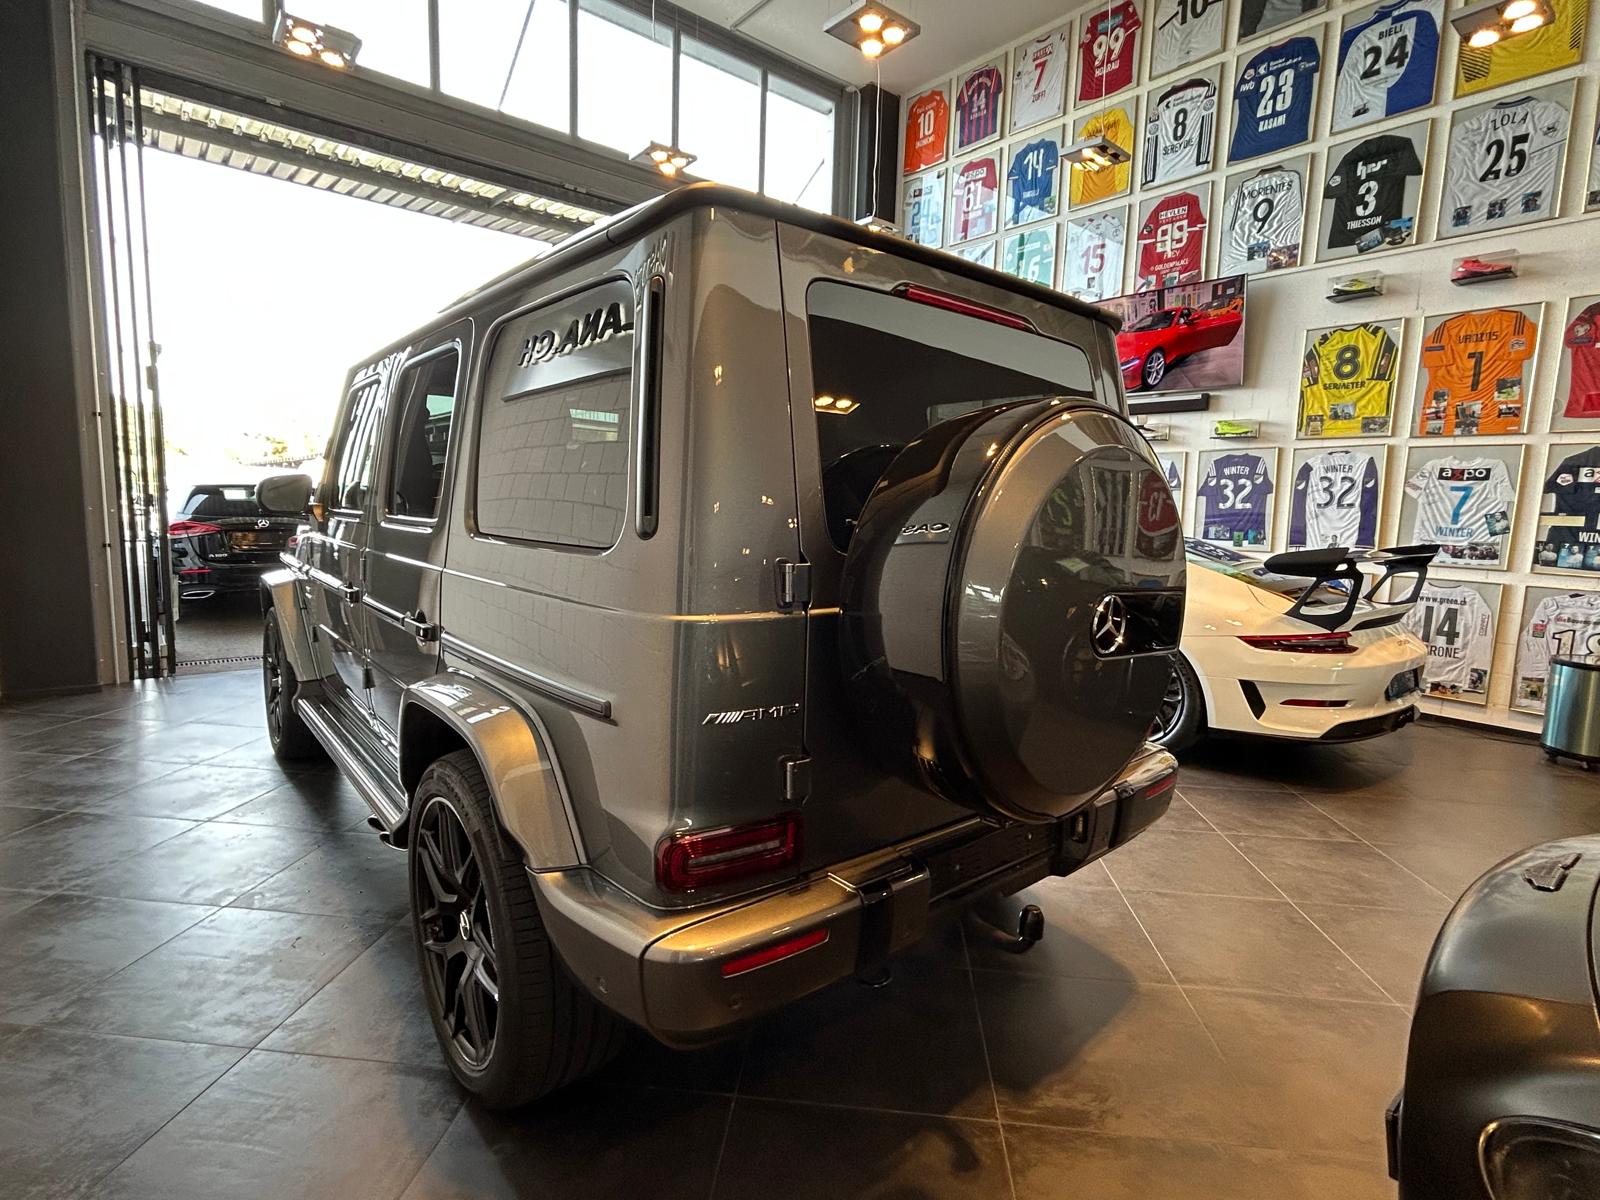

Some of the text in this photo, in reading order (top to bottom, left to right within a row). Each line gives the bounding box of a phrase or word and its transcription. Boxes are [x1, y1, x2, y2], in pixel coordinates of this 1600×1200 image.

[1093, 27, 1125, 67] 99
[1360, 34, 1409, 80] 24
[1034, 59, 1048, 92] 7
[1095, 59, 1120, 77] HORAU
[1257, 68, 1295, 118] 23
[918, 110, 934, 139] 10
[1173, 107, 1187, 141] 8
[1491, 111, 1529, 131] ZOLA
[1024, 148, 1043, 180] 14
[1479, 132, 1530, 182] 25
[964, 180, 983, 210] 61
[1242, 181, 1293, 200] MORIENTES
[1355, 180, 1378, 217] 3
[1160, 207, 1187, 218] HEYLEN
[1253, 198, 1274, 233] 9
[1346, 216, 1382, 230] THIESSON
[1156, 219, 1188, 258] 99
[1081, 243, 1106, 275] 15
[1333, 344, 1361, 380] 8
[1223, 466, 1249, 476] WINTER
[1323, 464, 1353, 473] WINTER
[1218, 478, 1252, 509] 32
[1316, 476, 1356, 509] 32
[1449, 486, 1473, 525] 7
[1435, 527, 1473, 538] WINTER
[1422, 605, 1460, 646] 14
